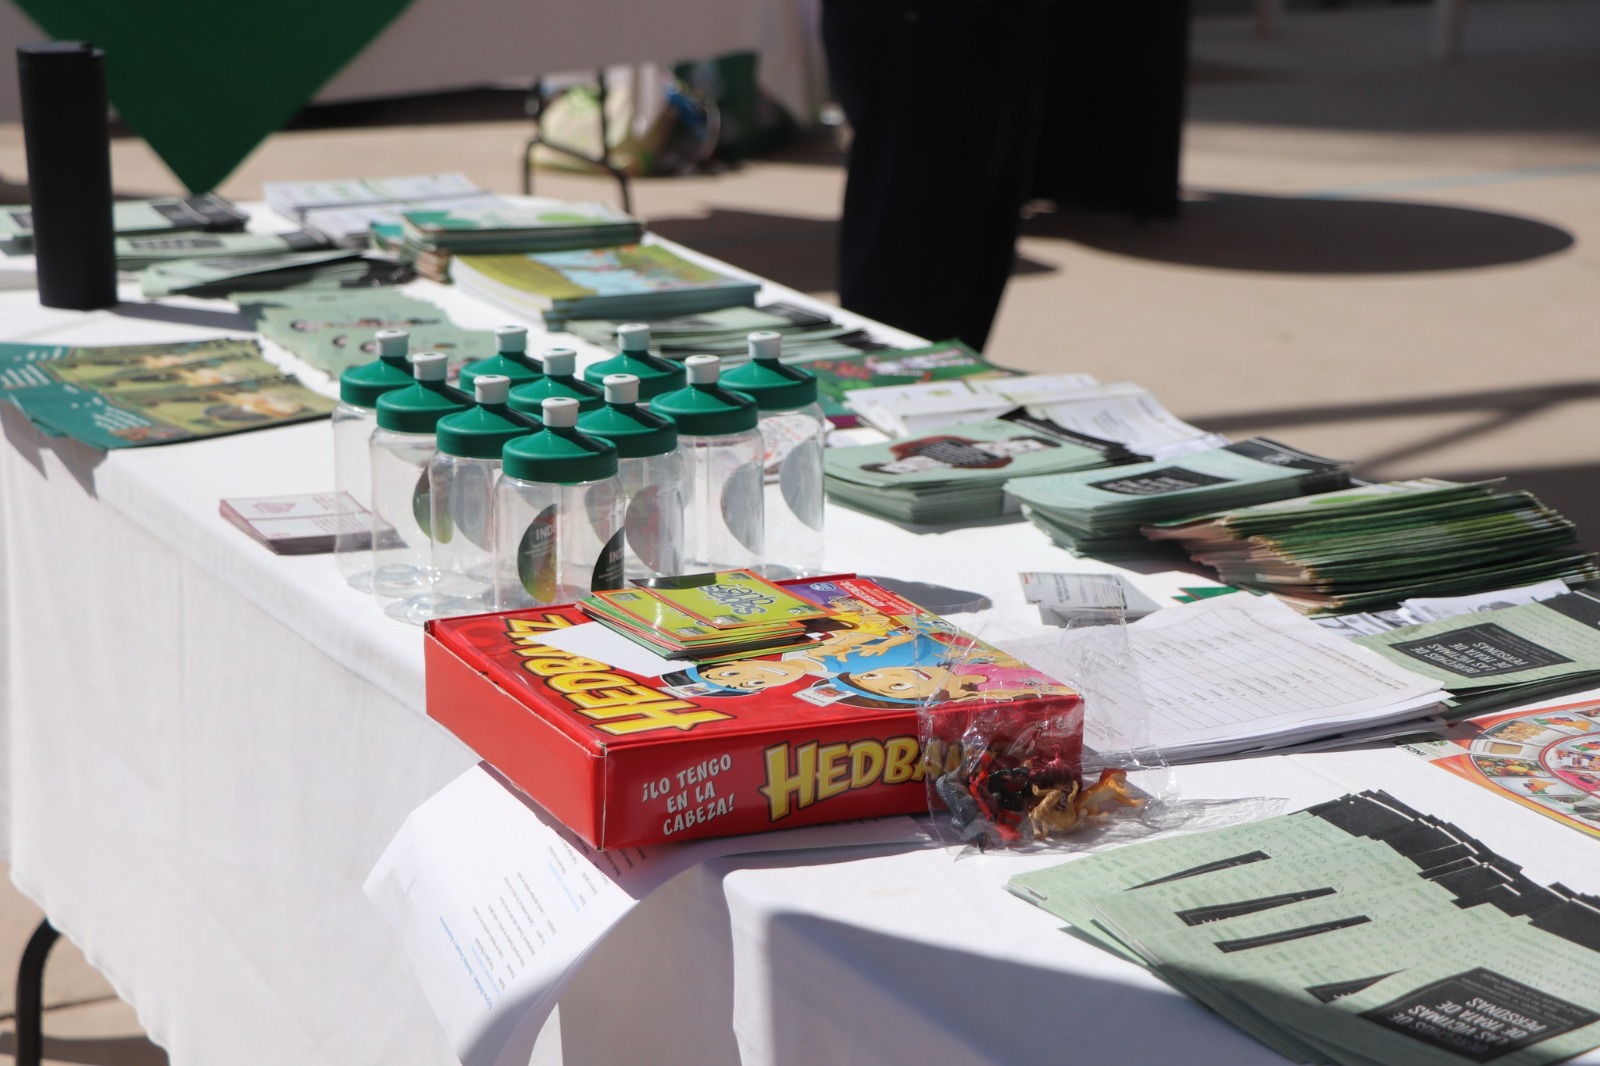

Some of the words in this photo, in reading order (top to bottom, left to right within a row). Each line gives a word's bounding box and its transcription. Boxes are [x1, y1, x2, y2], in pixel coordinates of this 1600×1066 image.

[1409, 646, 1428, 656] DE
[1449, 642, 1468, 652] DE
[1464, 648, 1493, 664] TRATA
[1472, 641, 1530, 666] PERSONAS
[1426, 651, 1481, 674] DERECHOS
[1473, 662, 1497, 673] LAS
[1495, 659, 1513, 669] DE
[503, 613, 738, 736] HEDBZ
[642, 777, 671, 803] ¡LO
[677, 754, 732, 787] TENGO
[666, 792, 691, 814] EN
[694, 782, 716, 804] LA
[663, 792, 735, 836] CABEZA!
[1435, 1000, 1462, 1018] DE
[1465, 997, 1547, 1032] PERSONAS
[1387, 1012, 1410, 1028] DE
[1458, 1009, 1503, 1032] TRATA
[1478, 1030, 1509, 1046] LAS
[1506, 1026, 1529, 1041] DE
